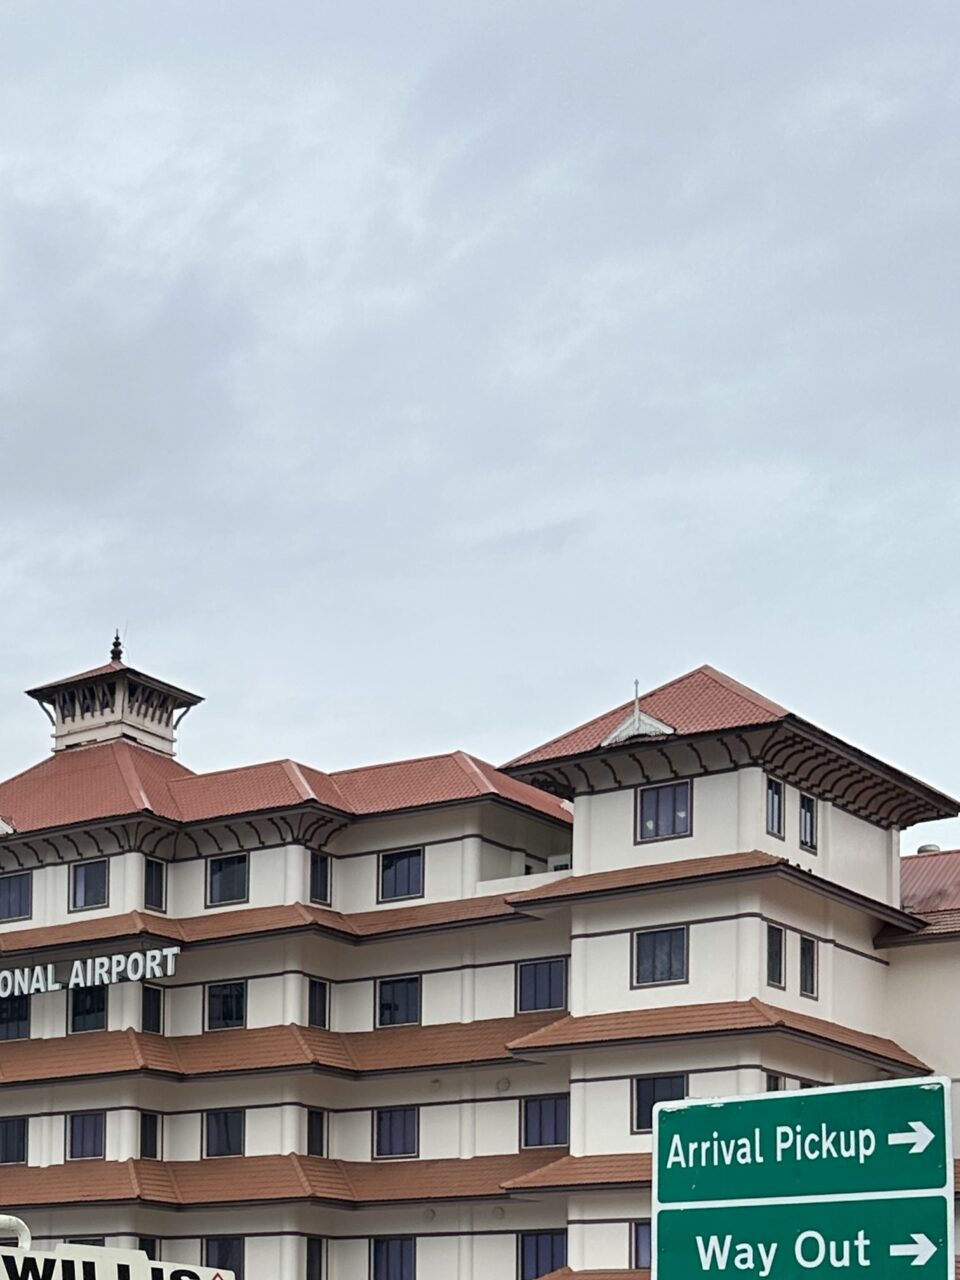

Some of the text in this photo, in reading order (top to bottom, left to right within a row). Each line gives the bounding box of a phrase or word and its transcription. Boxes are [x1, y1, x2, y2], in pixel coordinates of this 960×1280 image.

[69, 946, 181, 989] AIRPORT
[666, 1122, 876, 1169] Arrival Pickup
[695, 1230, 871, 1276] Way Out
